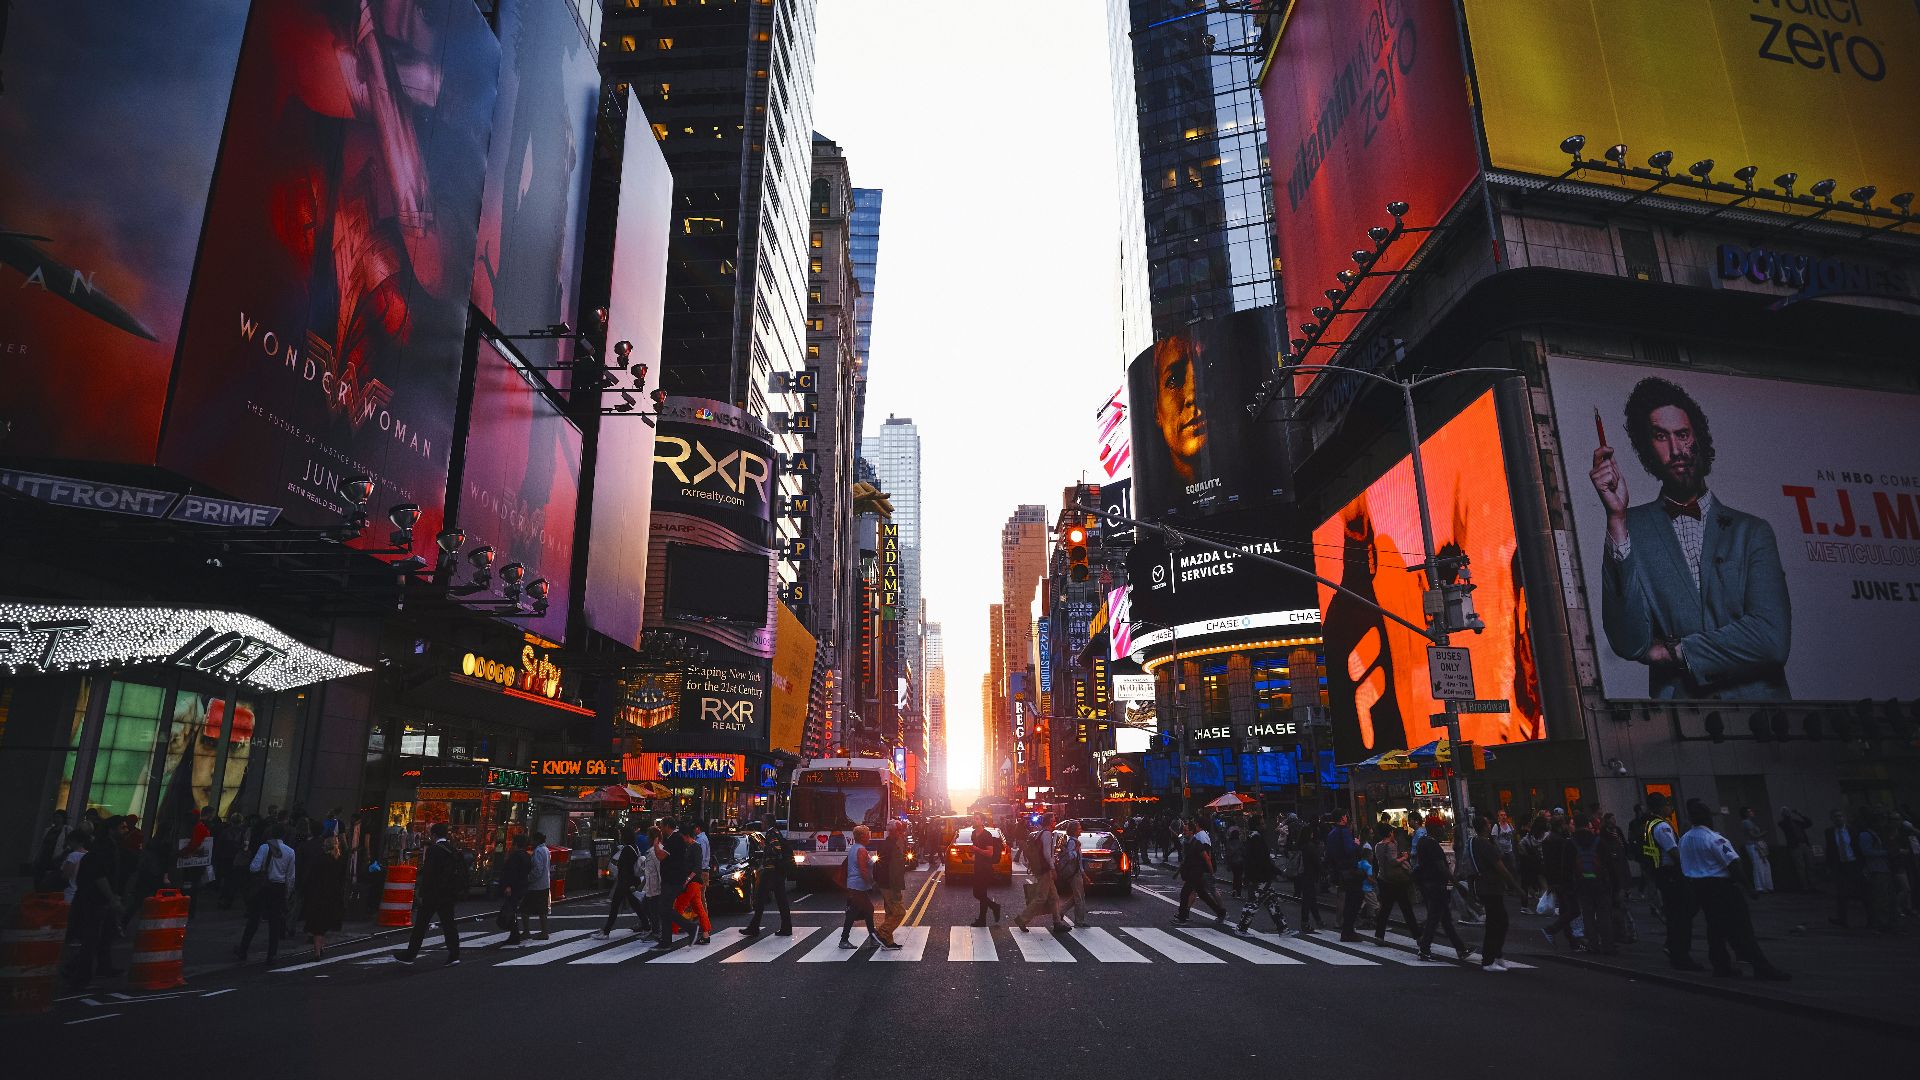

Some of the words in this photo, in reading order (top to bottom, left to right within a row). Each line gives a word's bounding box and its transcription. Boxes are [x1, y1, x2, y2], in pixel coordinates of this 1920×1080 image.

[1750, 14, 1886, 82] zero
[1361, 17, 1418, 148] zero
[240, 311, 350, 405] WONDER
[363, 396, 432, 460] WOMAN
[303, 459, 347, 494] JUN
[653, 435, 769, 502] RXR
[1816, 470, 1836, 482] AN
[1841, 471, 1874, 484] HBO
[681, 488, 745, 507] rxrrealty.com
[794, 375, 811, 600] CHAMPS
[185, 499, 270, 527] PRIME
[1782, 484, 1873, 538] T.J.
[1873, 491, 1920, 540] M
[651, 523, 696, 533] SHARP
[1180, 550, 1221, 568] MAZDA
[1806, 541, 1920, 567] METICULOU
[884, 524, 898, 606] MADAME
[1181, 562, 1235, 582] SERVICES
[1851, 579, 1904, 602] JUNE
[1206, 619, 1240, 631] CHASE
[172, 626, 287, 682] LOFT
[1436, 651, 1462, 661] BUSES
[729, 668, 747, 680] New
[1440, 662, 1460, 672] ONLY
[686, 679, 701, 690] for
[704, 680, 719, 691] the
[721, 681, 737, 693] 21st
[738, 684, 763, 699] Century
[1095, 658, 1107, 703] VICTORY
[700, 697, 755, 724] RXR
[1469, 701, 1507, 713] Broadway
[712, 722, 747, 731] REALTY
[1014, 702, 1025, 764] REGAL
[542, 760, 582, 775] KNOW
[657, 758, 736, 778] CHAMPS
[1414, 782, 1440, 796] SODA
